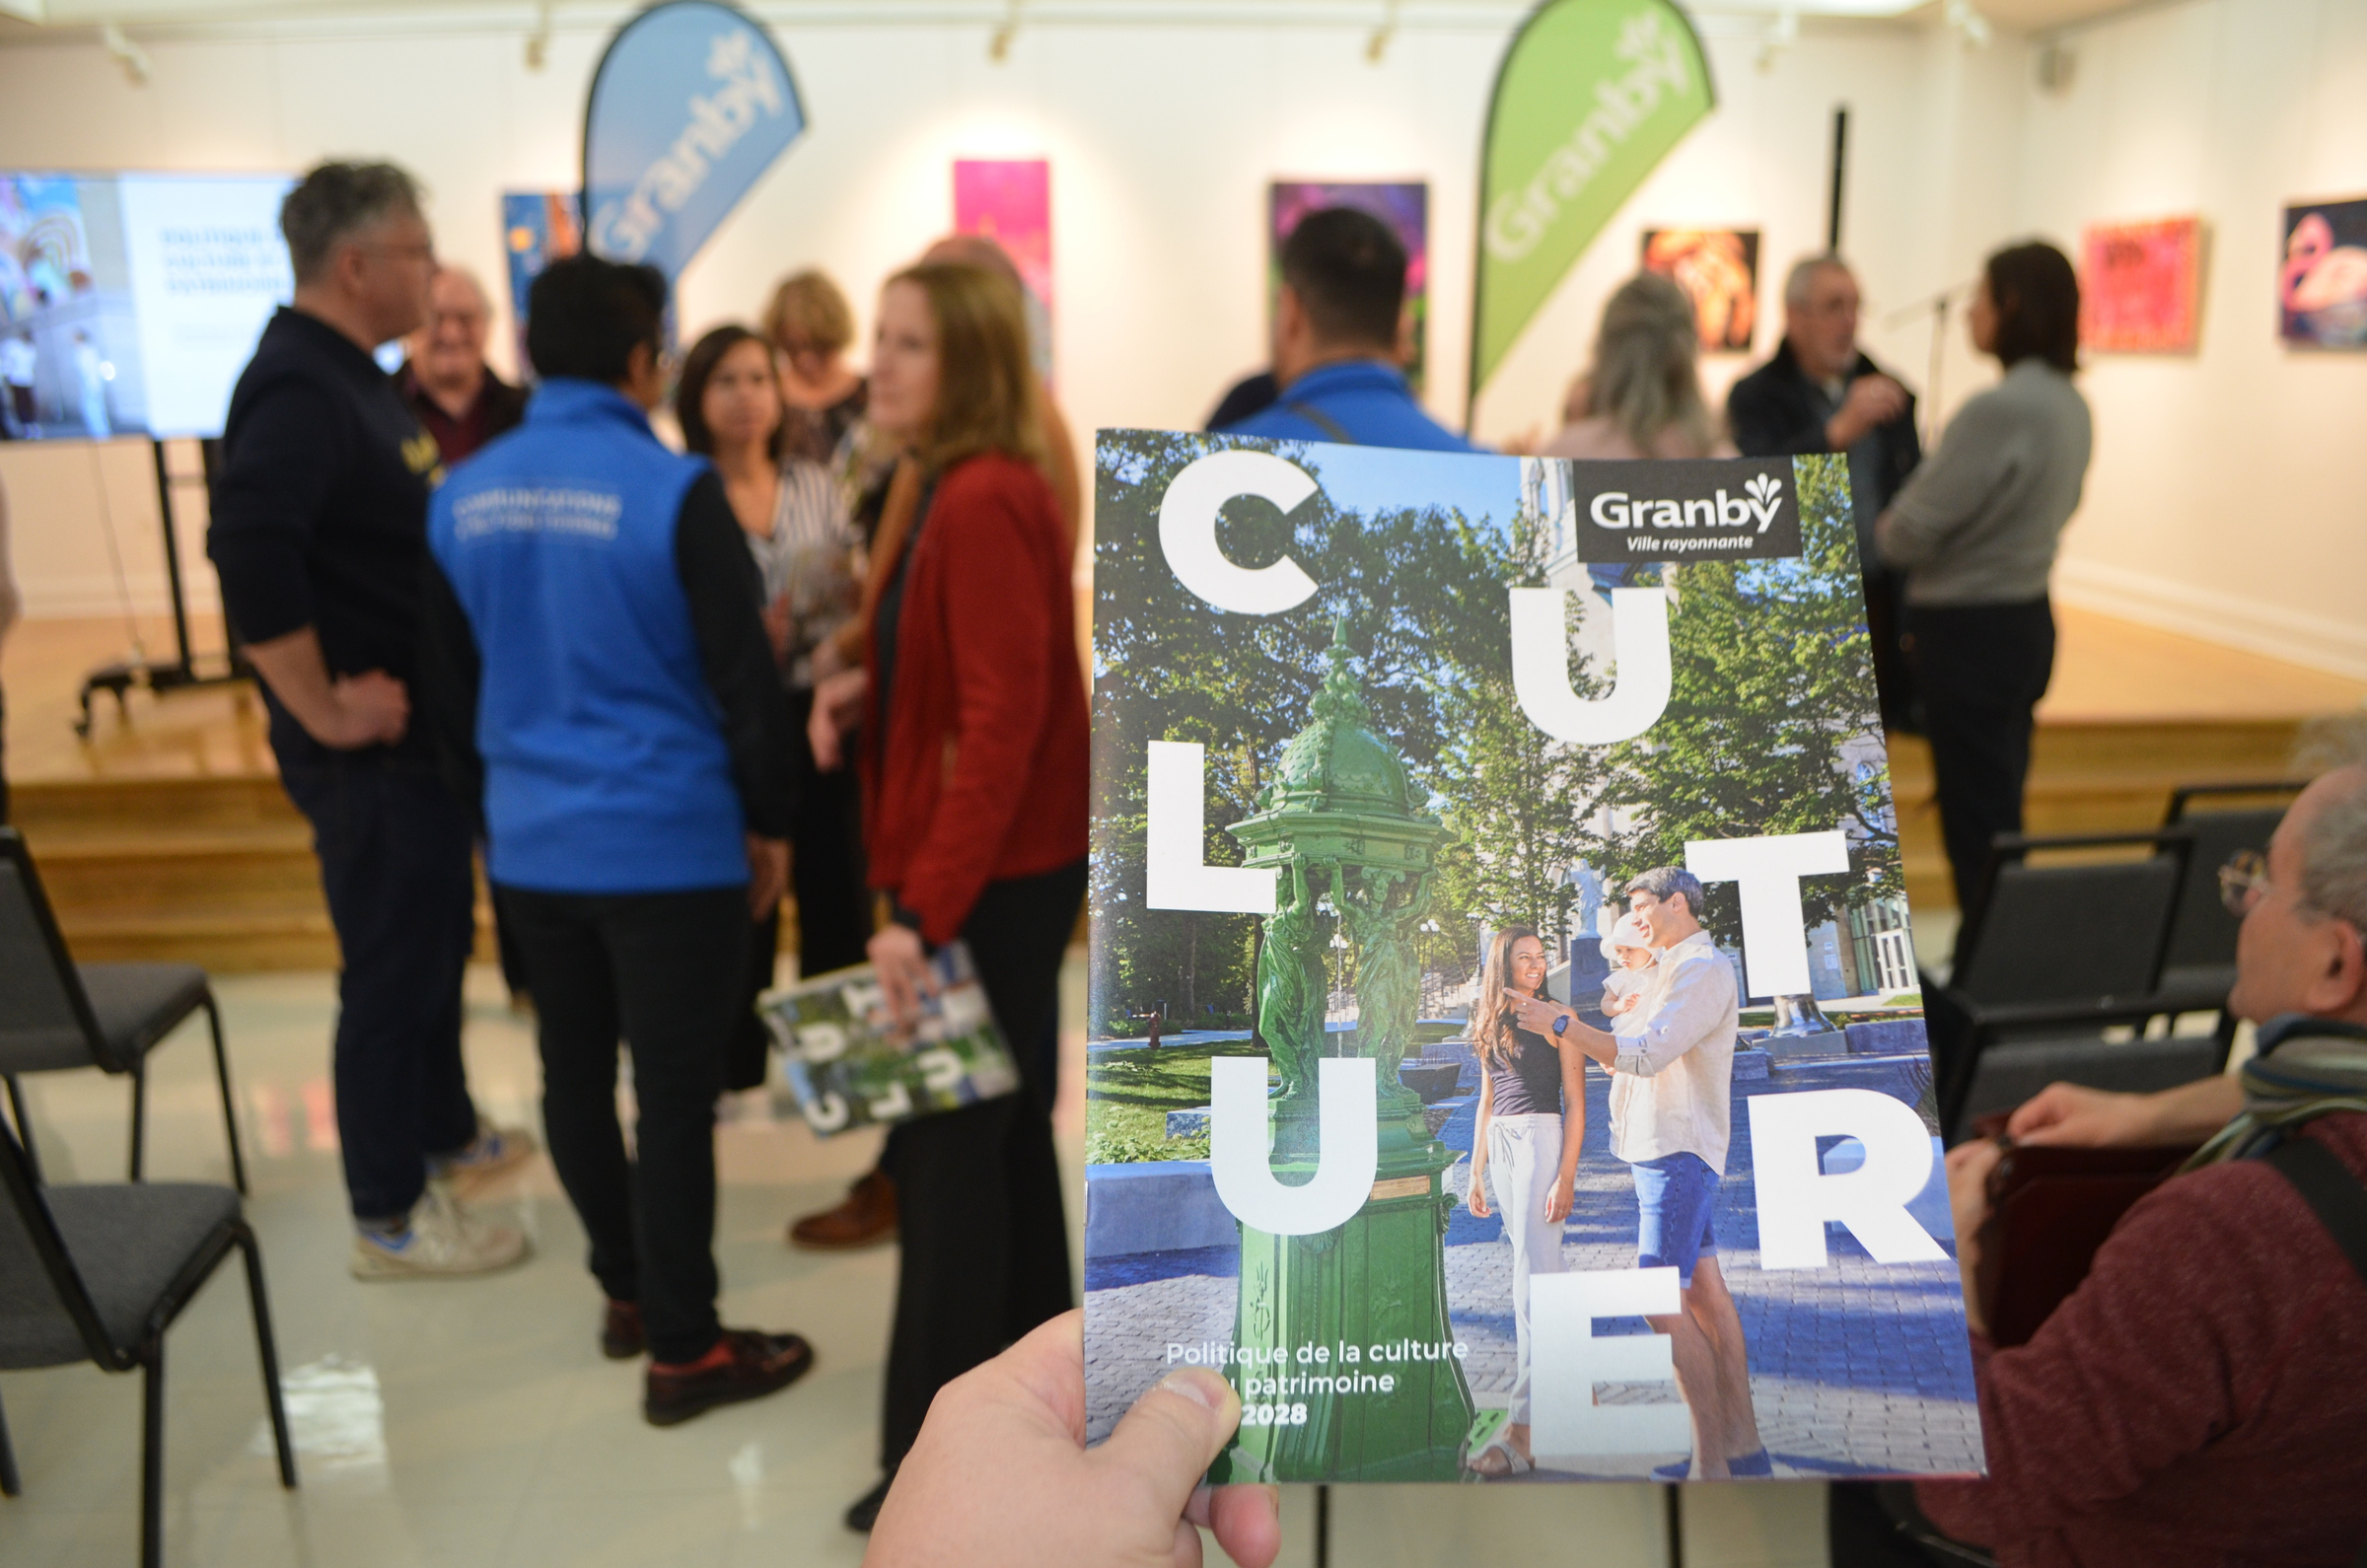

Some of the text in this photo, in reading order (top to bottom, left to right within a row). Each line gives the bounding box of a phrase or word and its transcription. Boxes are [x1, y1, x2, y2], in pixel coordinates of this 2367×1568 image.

[586, 32, 783, 264] Granby
[1482, 12, 1688, 262] Granby
[1590, 473, 1782, 534] Granby
[1627, 535, 1754, 553] Ville rayonnante
[1167, 1337, 1470, 1369] Politique de la culture
[1245, 1370, 1395, 1400] patrimoine
